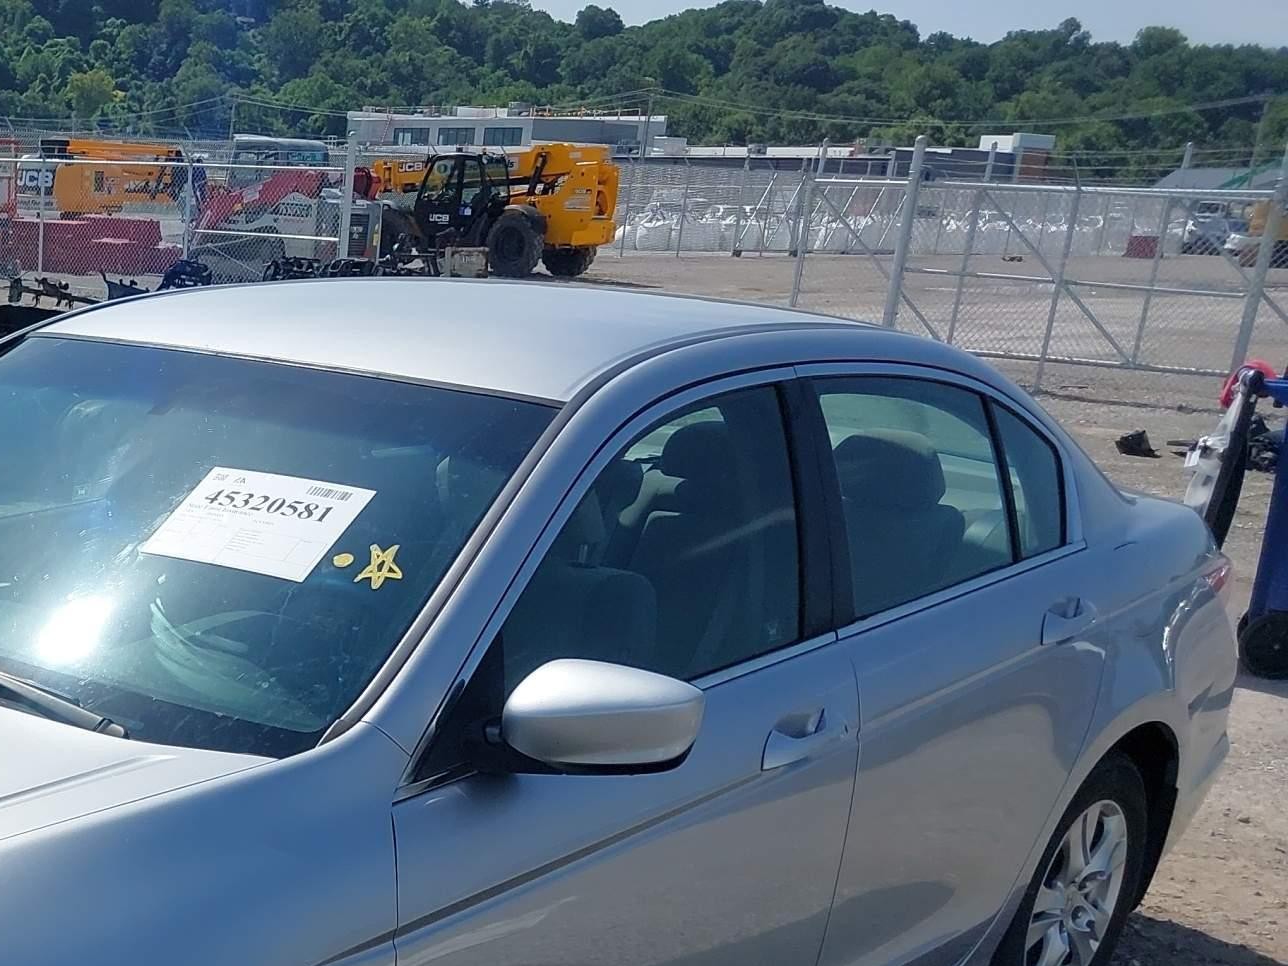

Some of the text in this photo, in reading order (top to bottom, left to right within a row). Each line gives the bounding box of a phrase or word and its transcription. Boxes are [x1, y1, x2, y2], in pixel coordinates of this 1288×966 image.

[399, 161, 424, 172] JCB
[16, 170, 53, 187] JCB
[429, 213, 449, 222] JCB
[204, 489, 334, 522] 45320581
